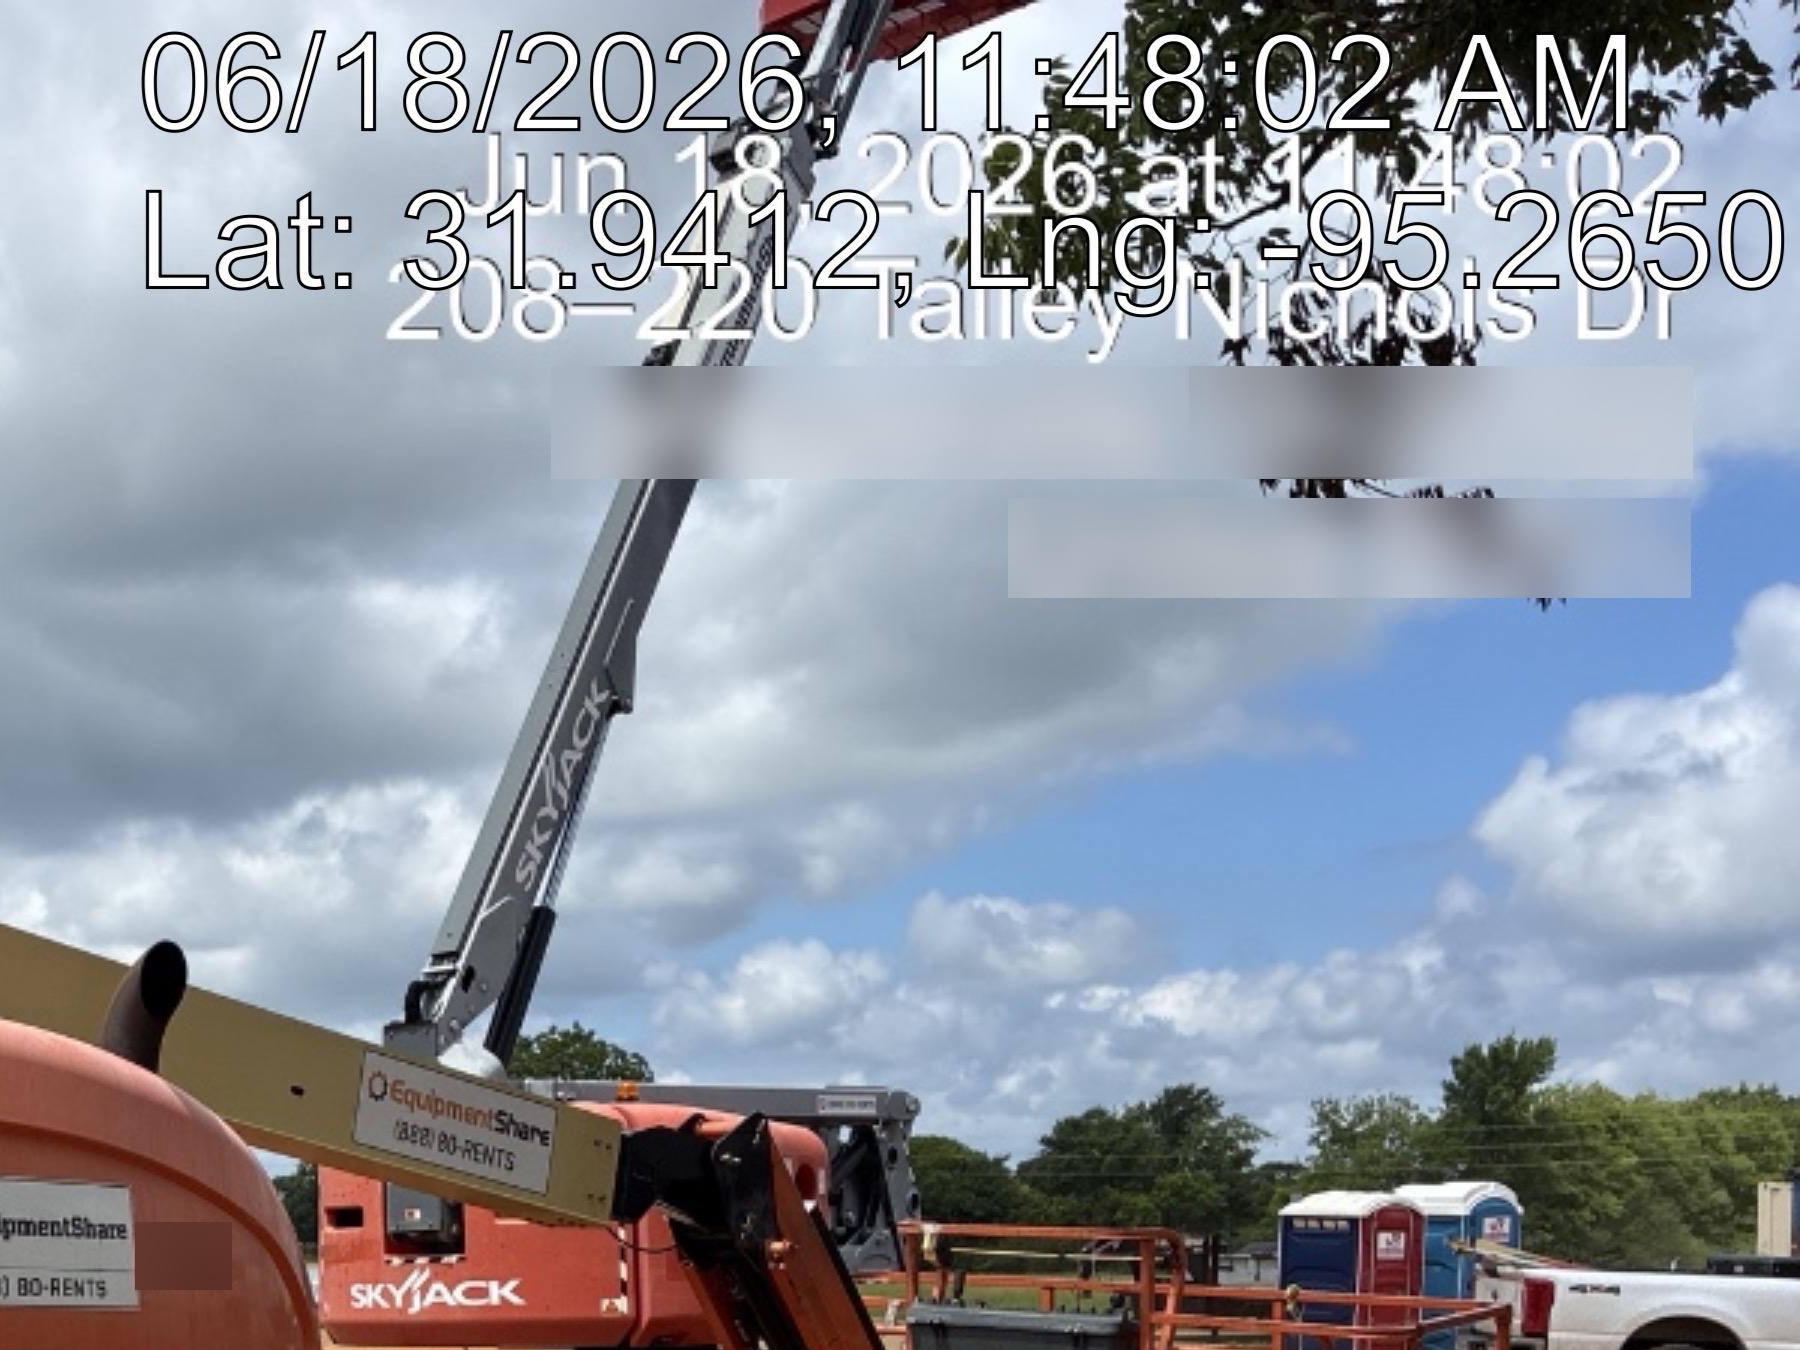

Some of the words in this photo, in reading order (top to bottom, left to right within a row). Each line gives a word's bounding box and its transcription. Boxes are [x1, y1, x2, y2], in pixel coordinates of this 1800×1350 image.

[515, 676, 612, 893] SKYJACK
[390, 1079, 550, 1147] EquipmentShare
[349, 1267, 527, 1315] SKYJACK
